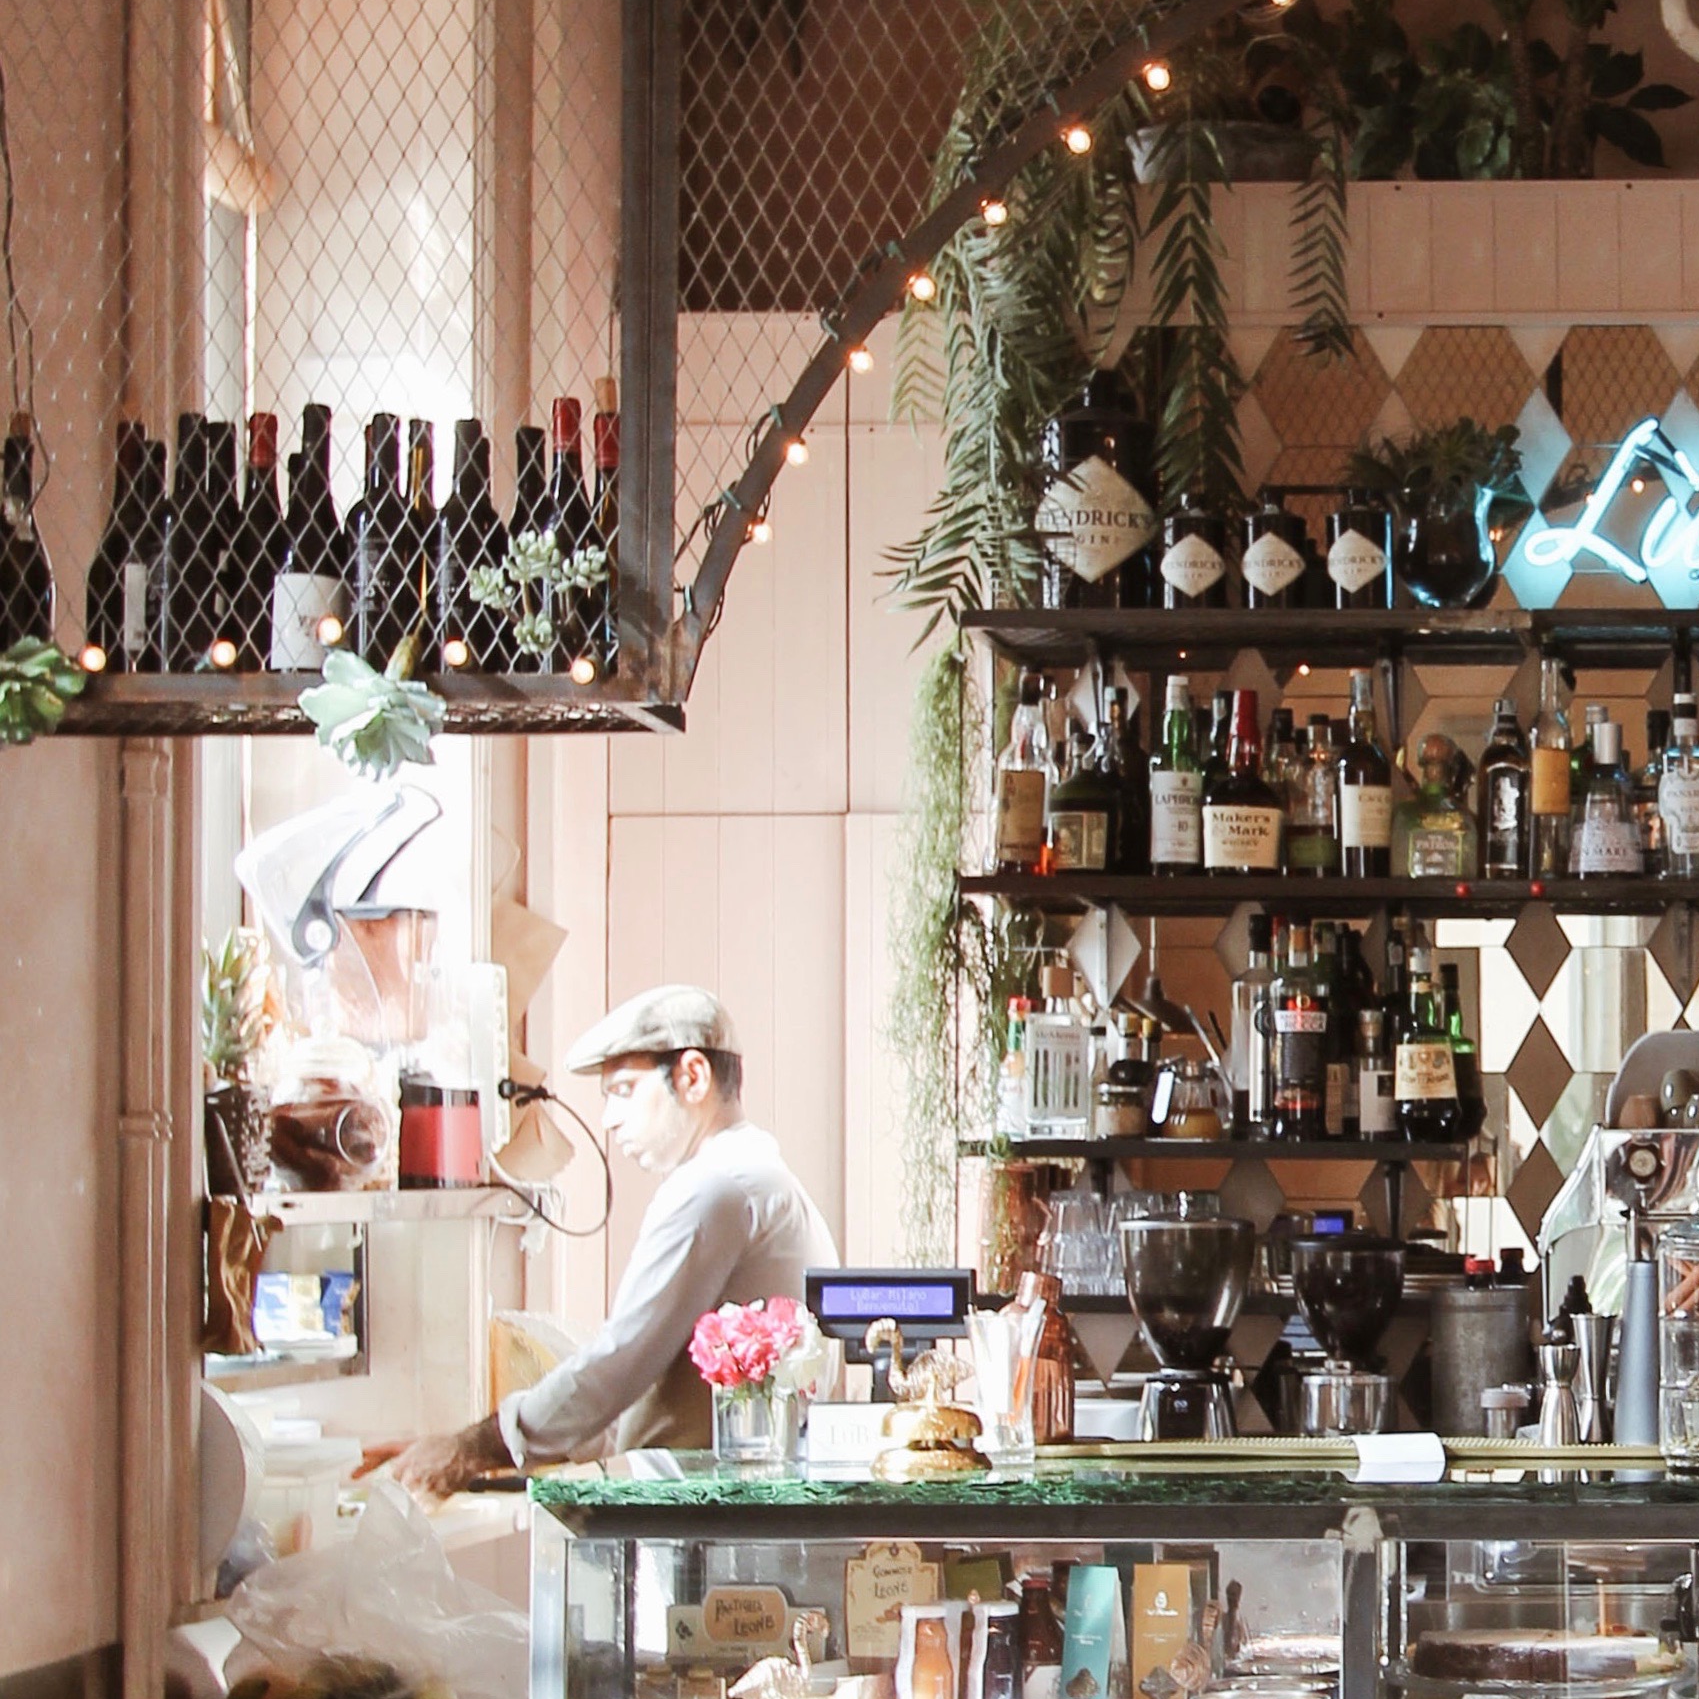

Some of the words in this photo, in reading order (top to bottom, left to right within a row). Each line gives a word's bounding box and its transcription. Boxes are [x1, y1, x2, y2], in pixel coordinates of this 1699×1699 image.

[1211, 812, 1271, 824] Maker's
[1227, 824, 1270, 838] Mark
[733, 1615, 775, 1637] LEONE
